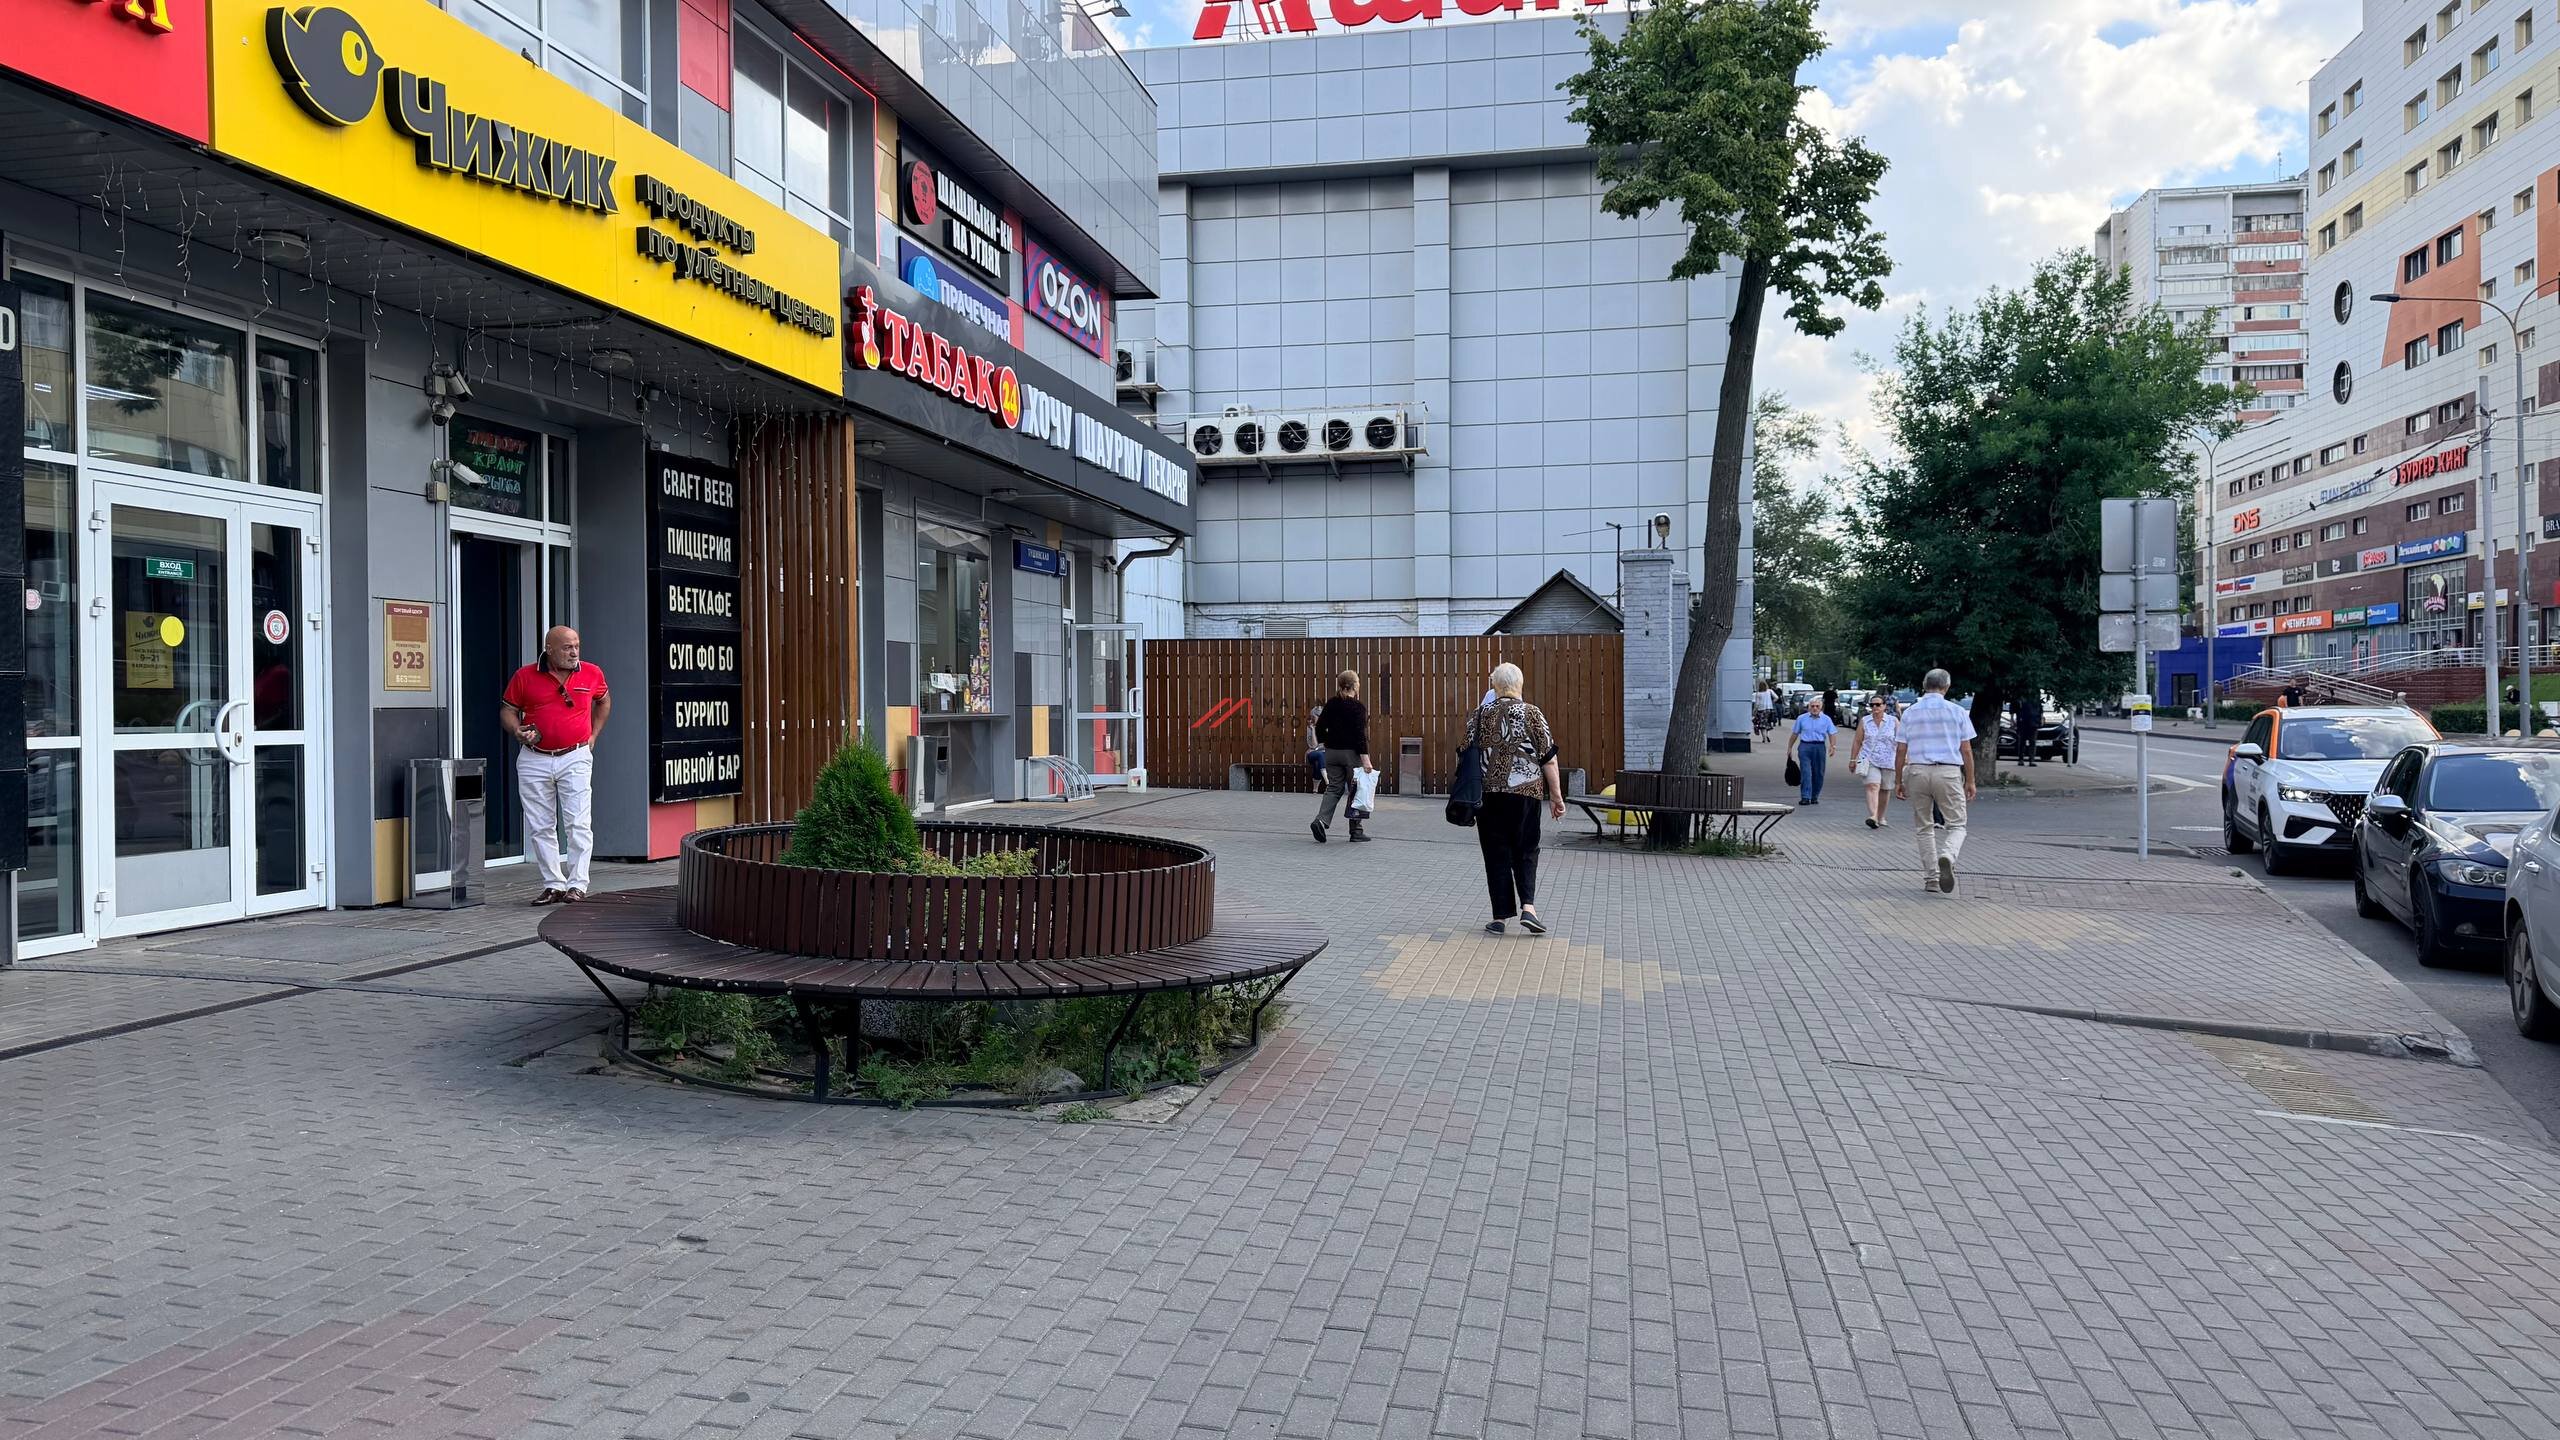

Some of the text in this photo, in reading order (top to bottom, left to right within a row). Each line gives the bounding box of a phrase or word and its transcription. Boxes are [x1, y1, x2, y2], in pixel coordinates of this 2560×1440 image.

[385, 67, 619, 214] Чижик
[636, 174, 756, 254] продукты
[952, 218, 1001, 279] НА УГЛЯХ
[637, 226, 836, 338] по улётным ценам
[1041, 262, 1101, 340] OZON
[939, 279, 1010, 344] ПРАЧЕЧНАЯ
[884, 308, 1018, 419] ТАБАК 24
[1024, 384, 1188, 507] ХОЧУ ШАУРМУ ПЕКАРНЯ
[2399, 456, 2436, 484] БУРГЕР
[2438, 446, 2469, 473] КИНГ
[662, 468, 734, 508] CRAFT BEER
[2232, 508, 2260, 534] DNS
[666, 527, 732, 562] ПИЦЦЕРИЯ
[159, 561, 181, 570] ВХОД
[668, 586, 732, 617] ВЬЕТКАФЕ
[668, 643, 734, 672] СУП ФО БО
[675, 700, 730, 728] БУРРИТО
[665, 751, 741, 786] ПИВНОЙ БАР
